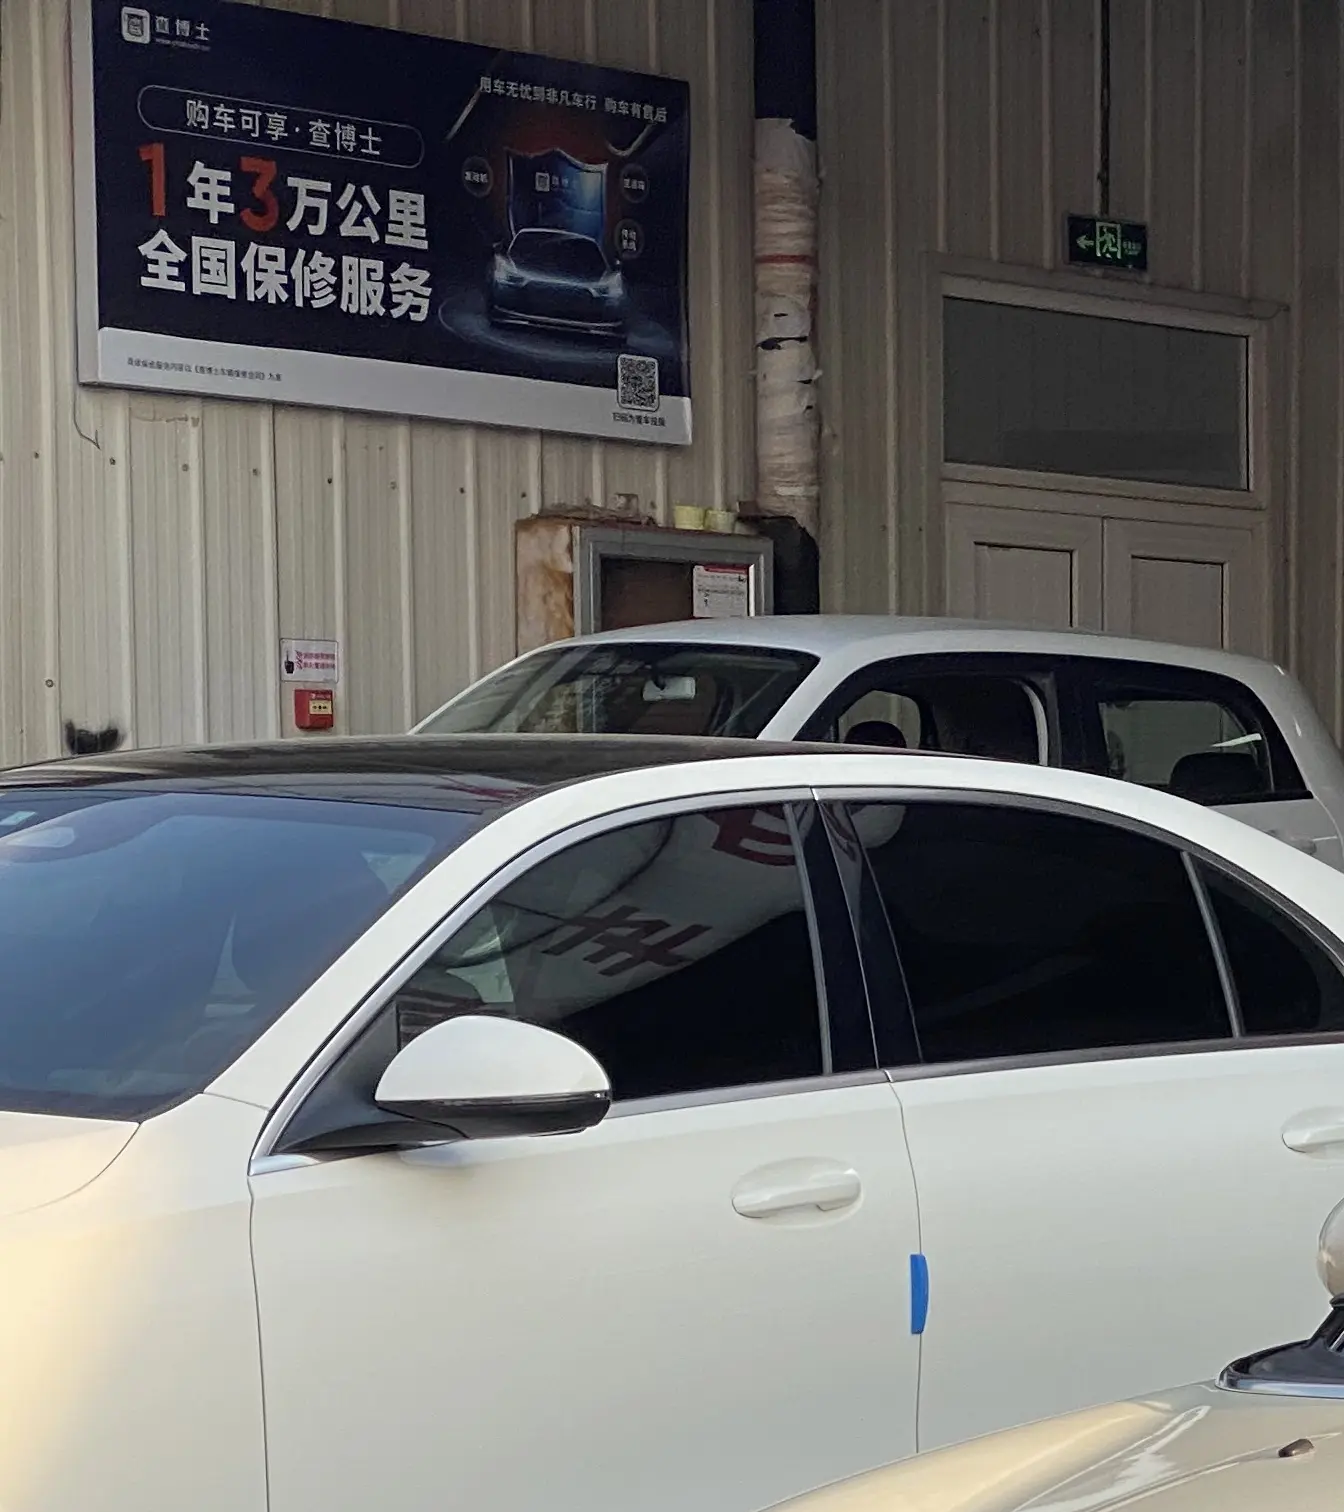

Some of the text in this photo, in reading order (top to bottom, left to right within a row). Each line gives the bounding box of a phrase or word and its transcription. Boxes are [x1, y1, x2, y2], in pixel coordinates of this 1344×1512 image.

[138, 142, 430, 253] 1年3万公里
[138, 227, 433, 323] 全国保修服务
